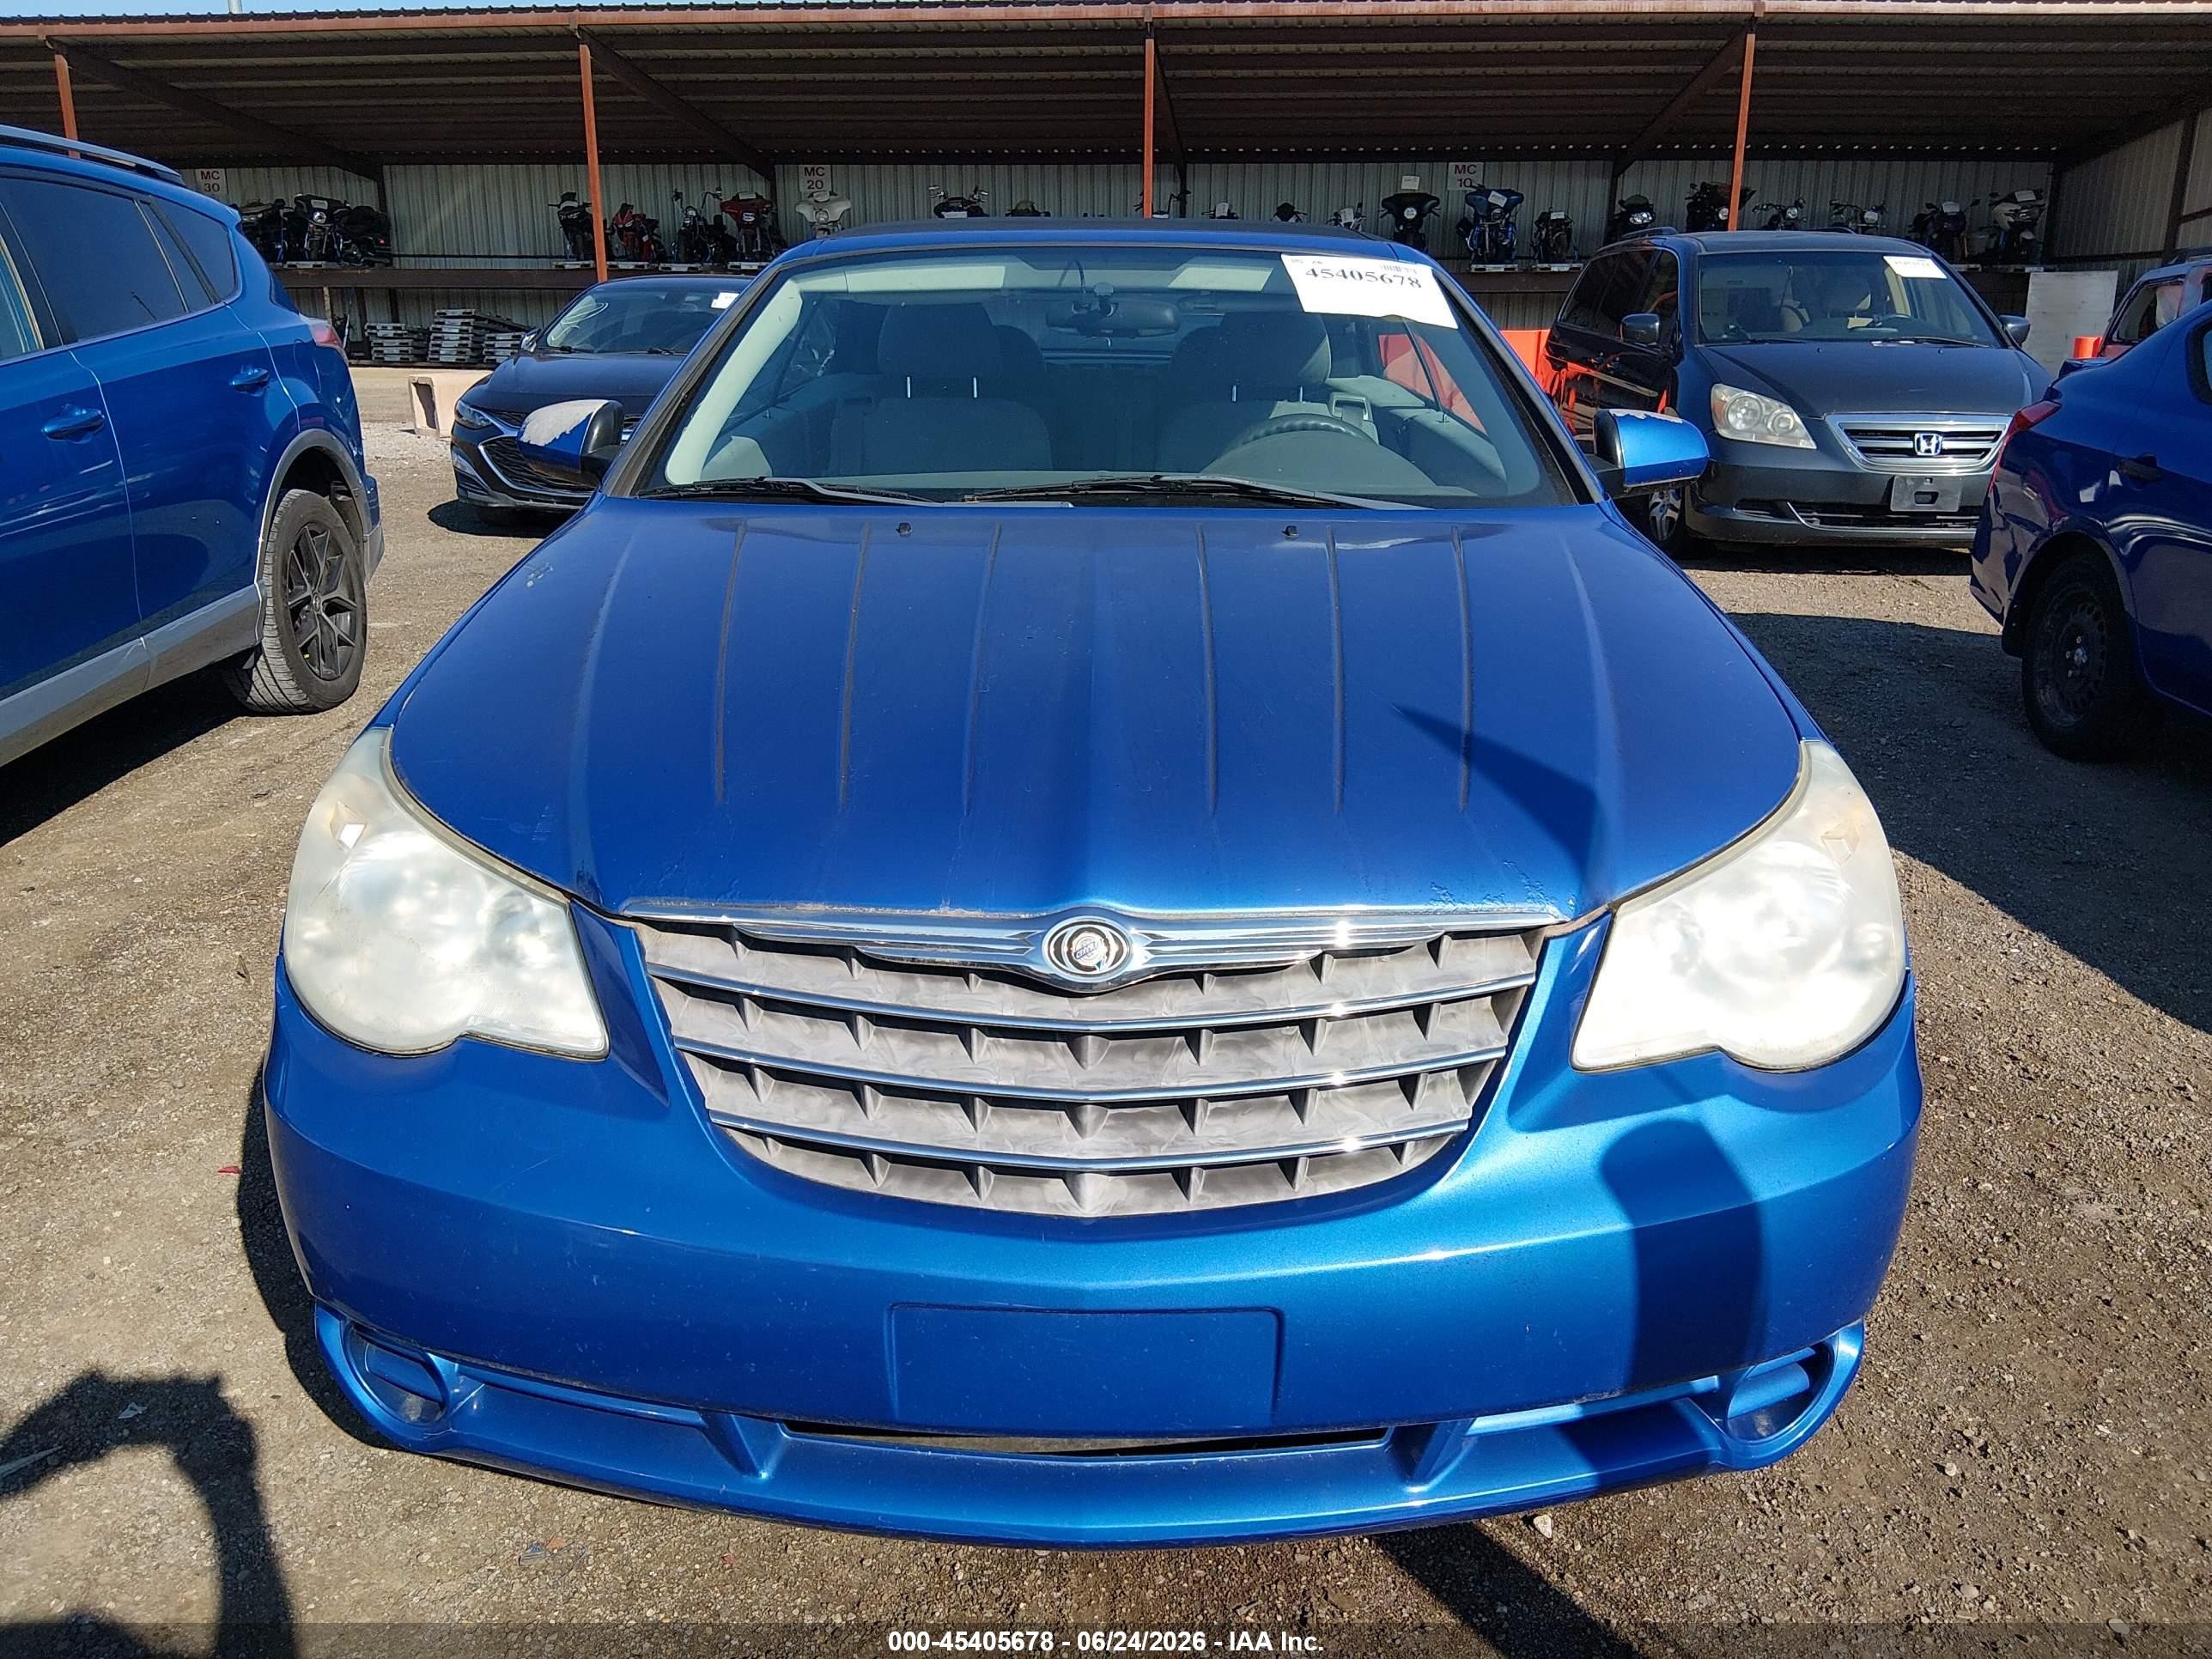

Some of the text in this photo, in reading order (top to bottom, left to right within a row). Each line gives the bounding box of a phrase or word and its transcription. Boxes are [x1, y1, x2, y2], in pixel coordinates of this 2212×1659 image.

[804, 167, 825, 177] MC
[1455, 164, 1477, 174] MC
[200, 170, 220, 180] MC
[204, 183, 221, 192] 30
[807, 179, 824, 190] 20
[1456, 178, 1473, 188] 10
[1305, 268, 1422, 288] 45405678
